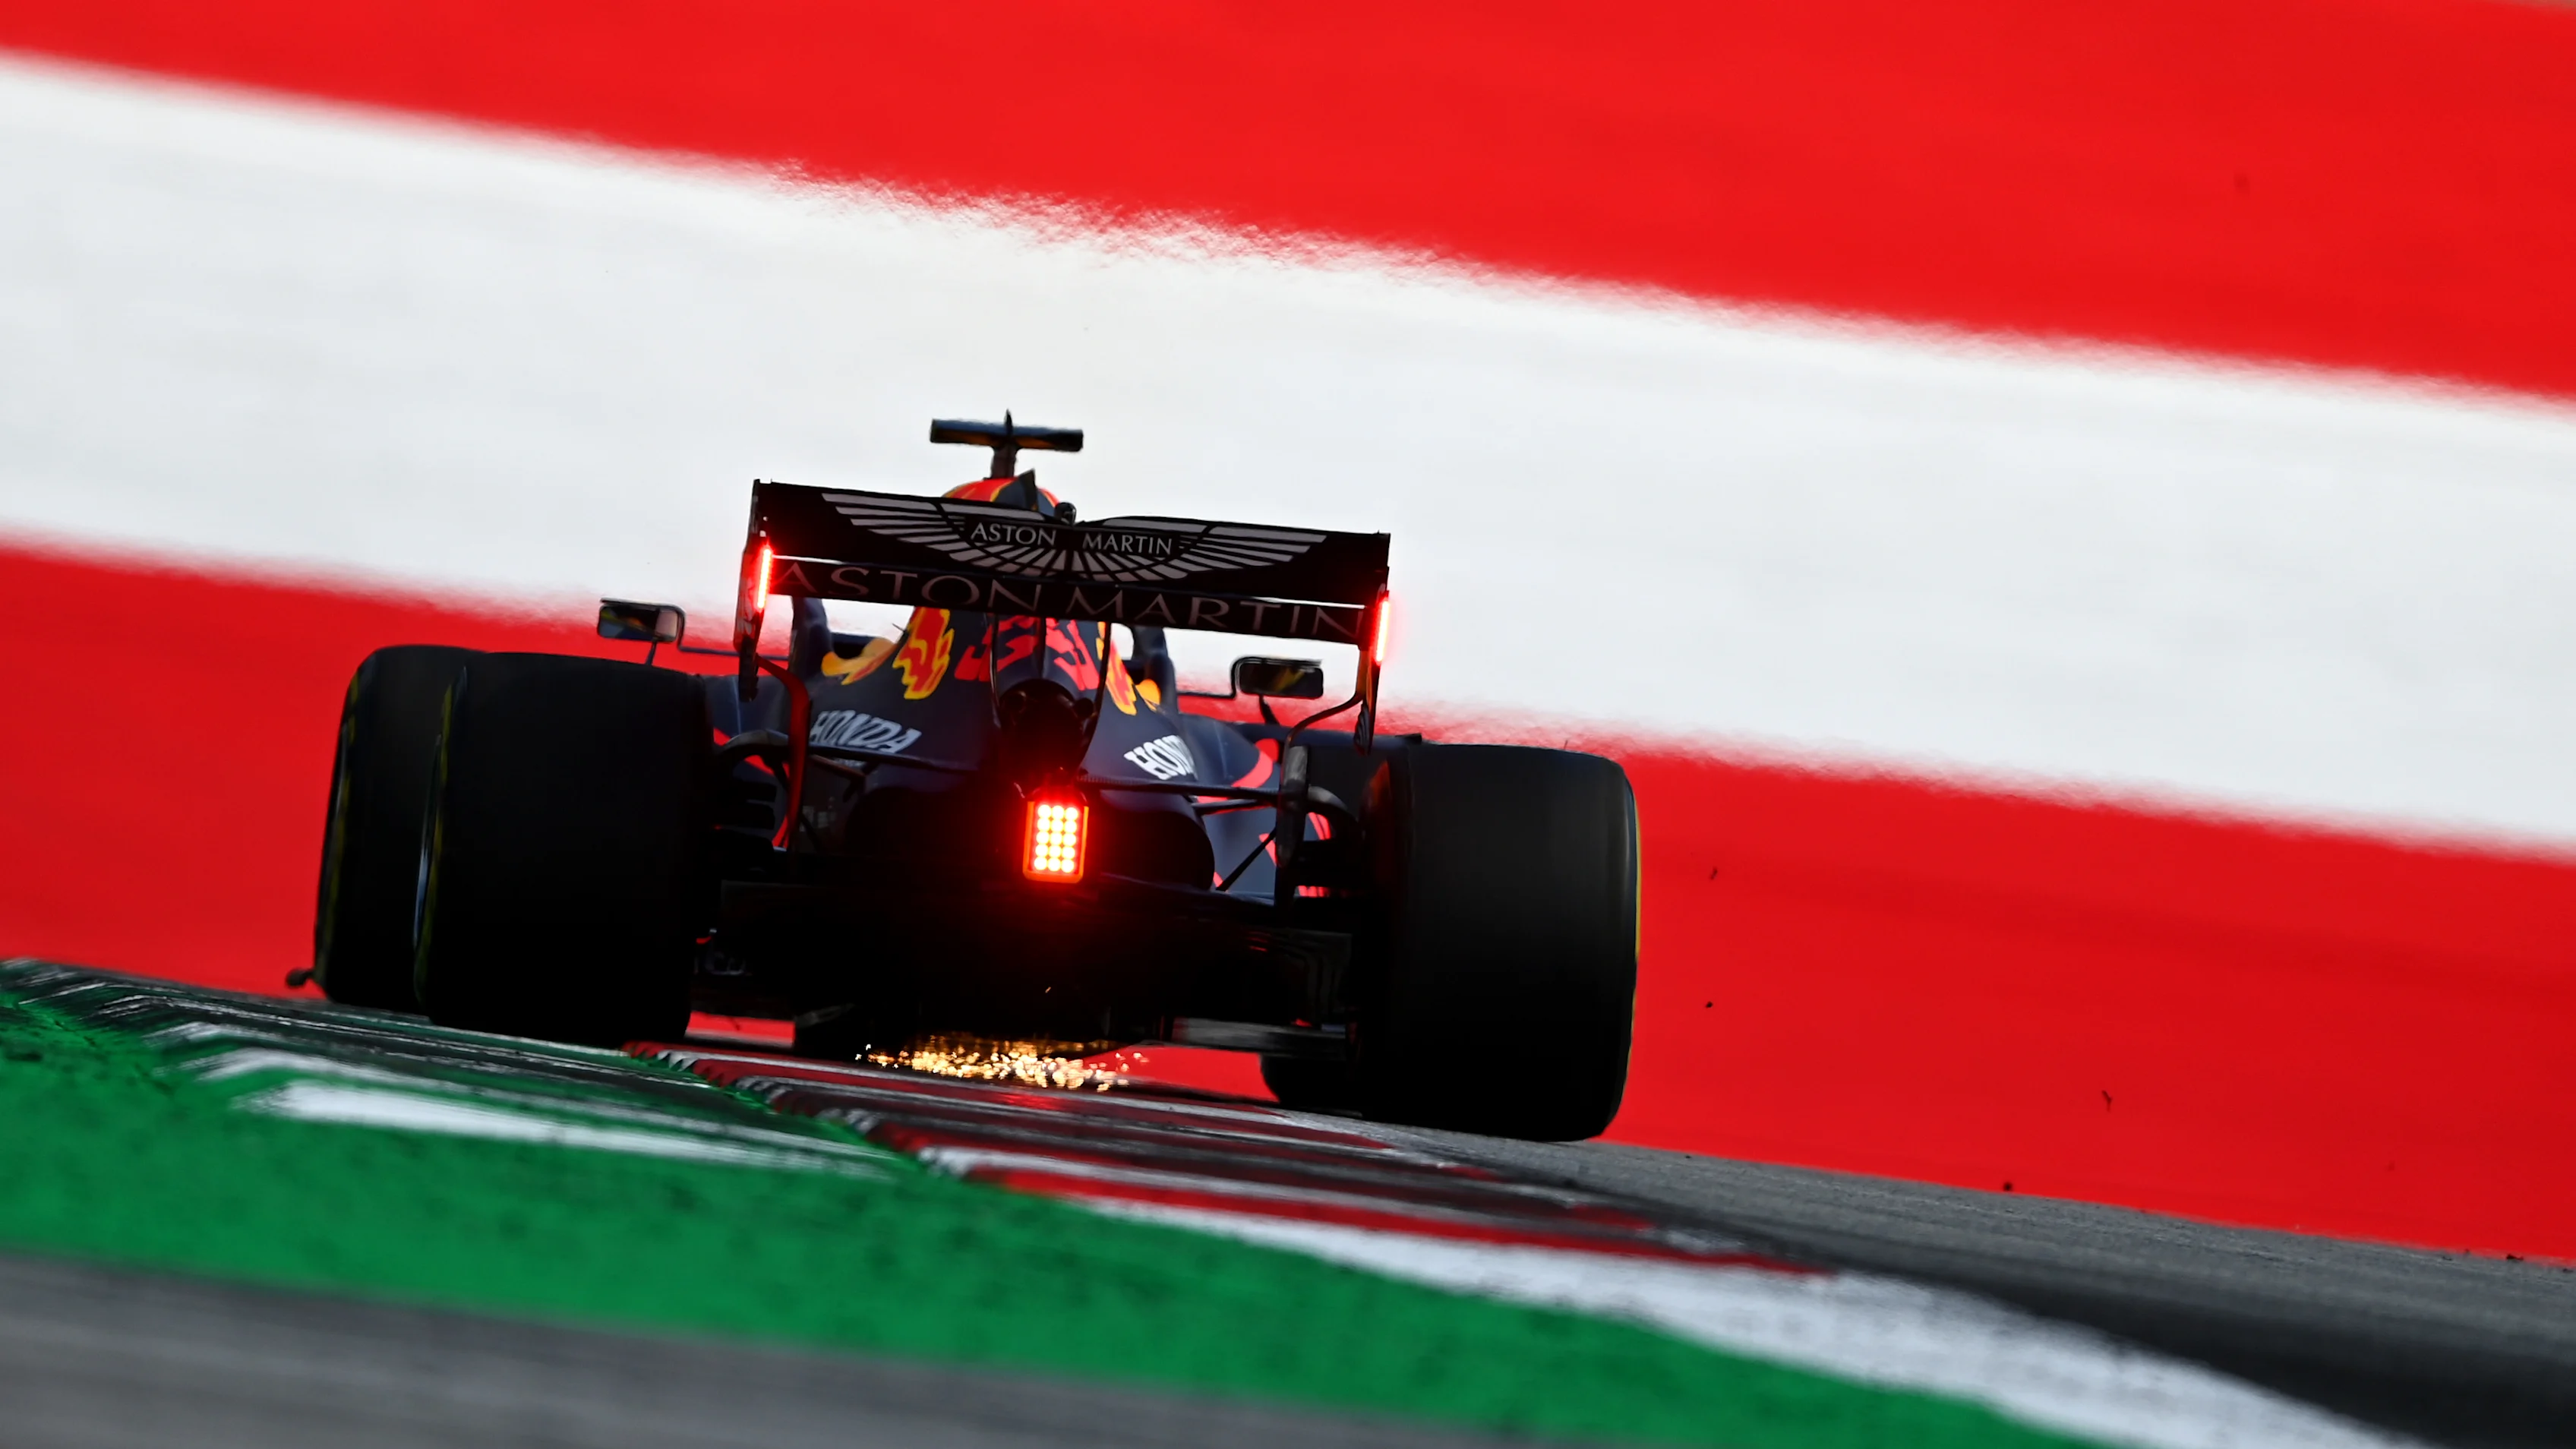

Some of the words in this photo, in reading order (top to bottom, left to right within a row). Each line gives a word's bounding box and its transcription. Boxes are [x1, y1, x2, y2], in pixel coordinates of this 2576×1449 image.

[971, 522, 1056, 545] ASTON
[1082, 532, 1173, 556] MARTIN
[776, 561, 1042, 611] ASTON
[1065, 586, 1364, 638] MARTIN
[809, 709, 922, 754] HONDA
[1123, 734, 1198, 780] HON
